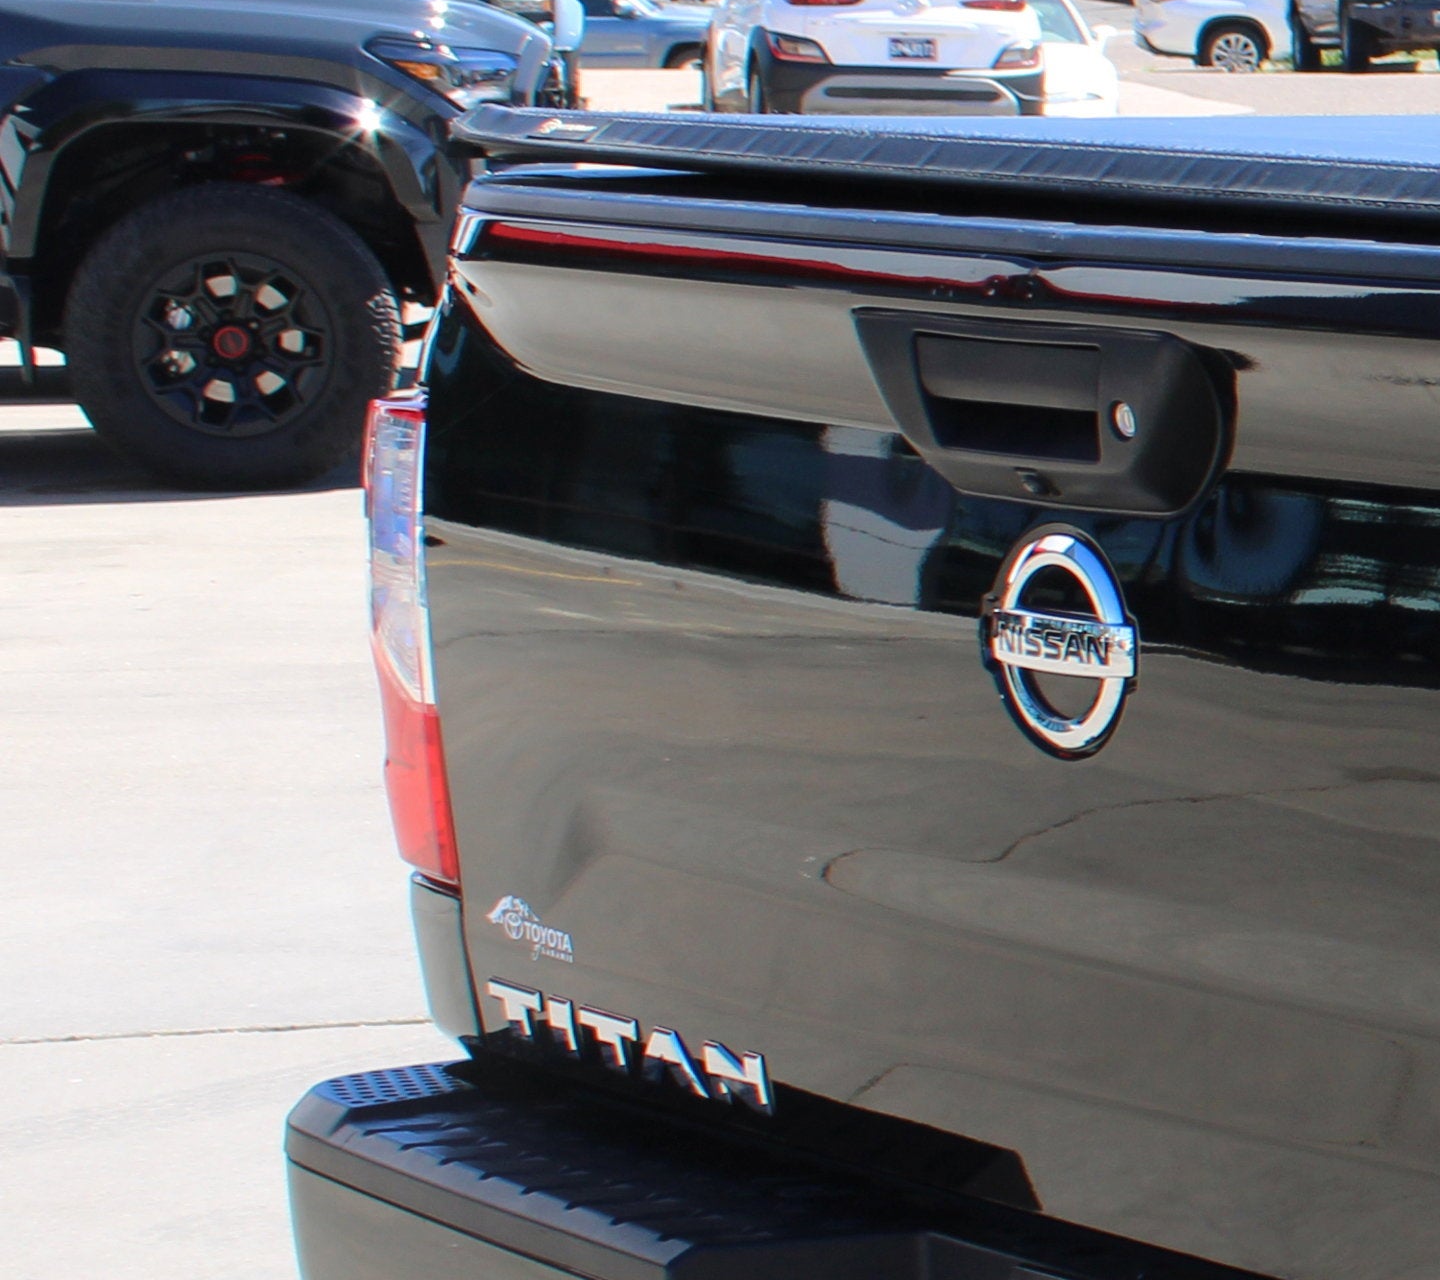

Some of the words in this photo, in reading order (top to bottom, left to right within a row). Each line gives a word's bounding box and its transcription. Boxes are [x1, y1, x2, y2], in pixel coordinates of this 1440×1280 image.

[997, 622, 1111, 666] NISSAN
[523, 921, 574, 953] TOYOTA
[487, 975, 772, 1112] TITAN
